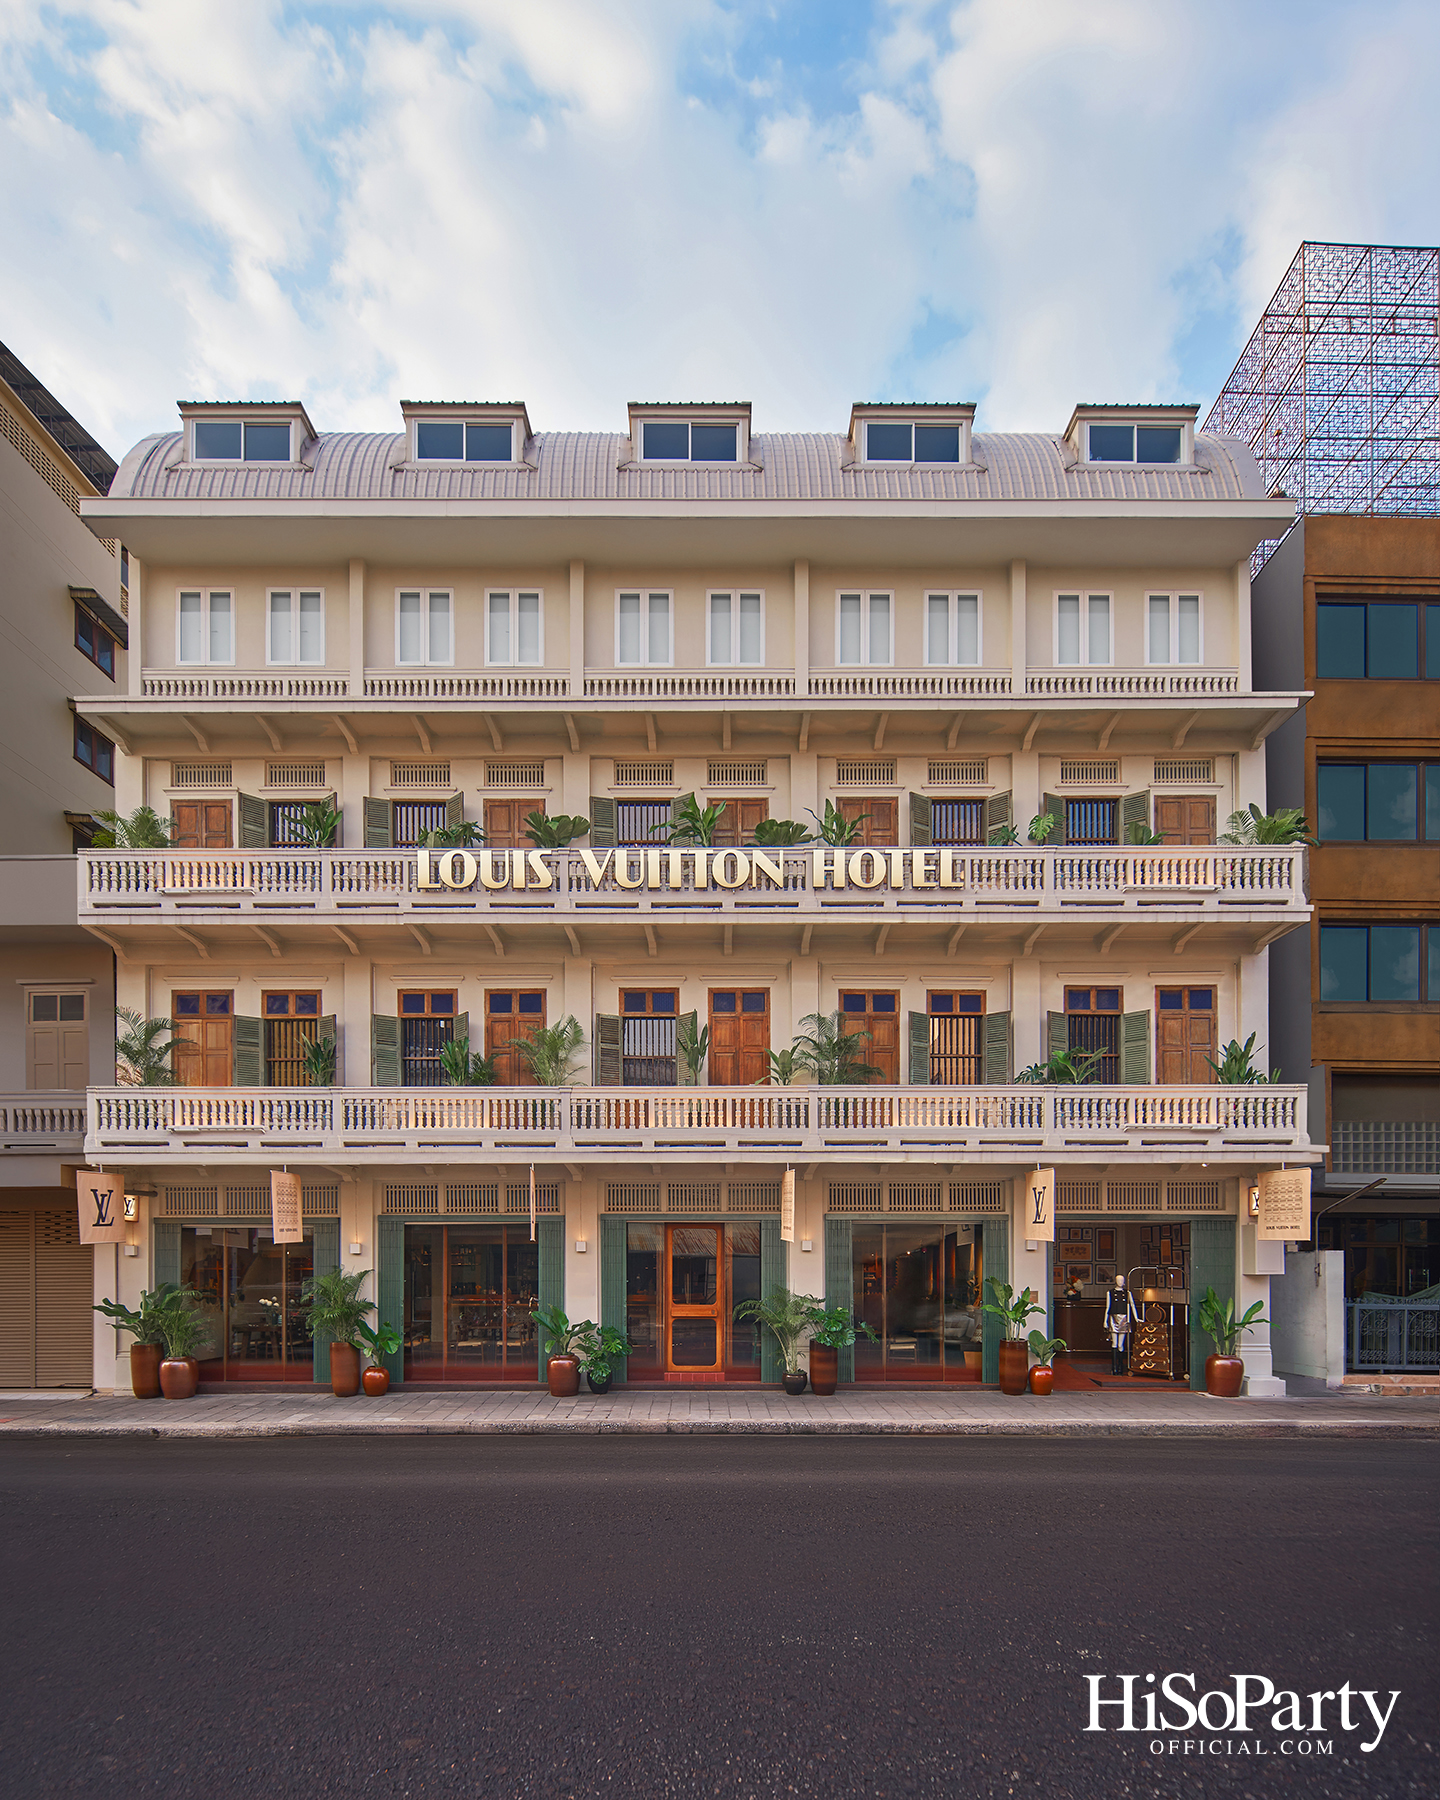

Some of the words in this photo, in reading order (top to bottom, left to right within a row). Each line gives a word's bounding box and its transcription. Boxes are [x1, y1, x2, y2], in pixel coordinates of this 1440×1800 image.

[417, 849, 553, 889] LOUIS
[578, 849, 784, 889] VUITTON
[812, 849, 965, 889] HOTEL
